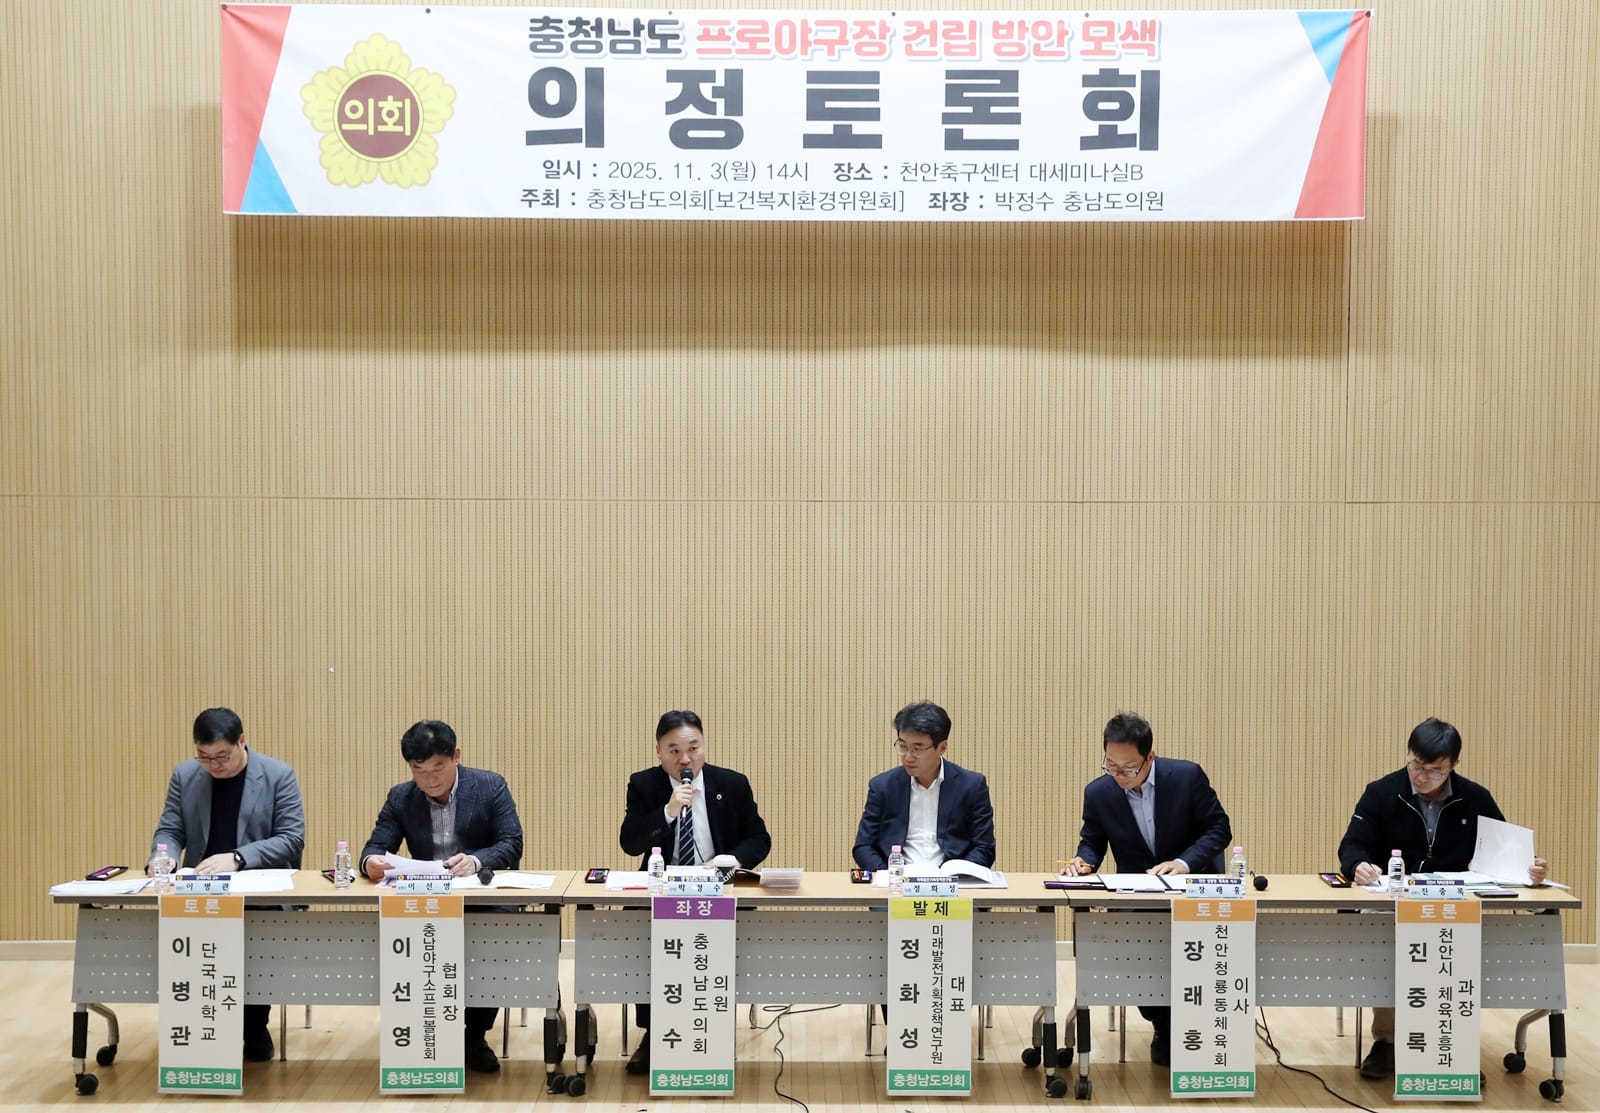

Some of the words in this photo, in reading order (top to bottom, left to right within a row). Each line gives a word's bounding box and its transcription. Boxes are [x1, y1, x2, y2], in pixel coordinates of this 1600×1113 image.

[528, 16, 684, 56] 충청남도
[694, 18, 892, 58] 프로야구장
[904, 19, 980, 58] 건립
[991, 19, 1072, 58] 방안
[1079, 19, 1160, 58] 모색
[341, 95, 412, 137] 의회
[542, 159, 582, 180] 일시
[608, 161, 662, 181] 2025.
[673, 162, 701, 181] 11.
[710, 161, 758, 183] 3(월)
[767, 161, 809, 182] 14시
[833, 161, 873, 183] 장소
[899, 162, 1020, 183] 천안축구센터
[1029, 162, 1145, 183] 대세미나실B
[520, 188, 561, 209] 주최
[586, 188, 906, 213] 충청남도의회[보건복지환경위원회]
[928, 191, 970, 212] 좌장
[994, 191, 1056, 212] 박정수
[1063, 191, 1165, 212] 충남도의원
[183, 899, 221, 915] 토론
[403, 899, 441, 915] 토론
[676, 900, 713, 916] 좌장
[912, 900, 949, 917] 발제
[1195, 903, 1233, 919] 토론
[1420, 904, 1458, 920] 토론
[1437, 927, 1455, 977] 천안시
[171, 936, 192, 1047] 이병관
[200, 942, 218, 1041] 단국대학교
[220, 975, 238, 1012] 교수
[391, 936, 412, 1048] 이선영
[422, 922, 437, 1062] 충남야구소프트볼협회
[441, 962, 459, 1022] 협회장
[662, 938, 684, 1049] 박정수
[692, 932, 710, 1055] 충청남도의회
[713, 975, 729, 1013] 의원
[899, 938, 921, 1049] 정화성
[930, 924, 945, 1065] 미래발전기획정책연구원
[949, 975, 966, 1012] 대표
[1182, 940, 1205, 1051] 장래홍
[1213, 924, 1230, 1067] 천안청룡동체육회
[1233, 976, 1250, 1015] 이사
[1406, 942, 1428, 1053] 진중록
[1457, 978, 1475, 1017] 과장
[1436, 985, 1455, 1069] 체육진흥과
[165, 1070, 238, 1087] 충청남도의회
[386, 1070, 459, 1087] 충청남도의회
[655, 1072, 729, 1088] 충청남도의회
[892, 1072, 965, 1088] 충청남도의회
[1177, 1075, 1250, 1090] 충청남도의회
[1401, 1076, 1474, 1092] 충청남도의회
